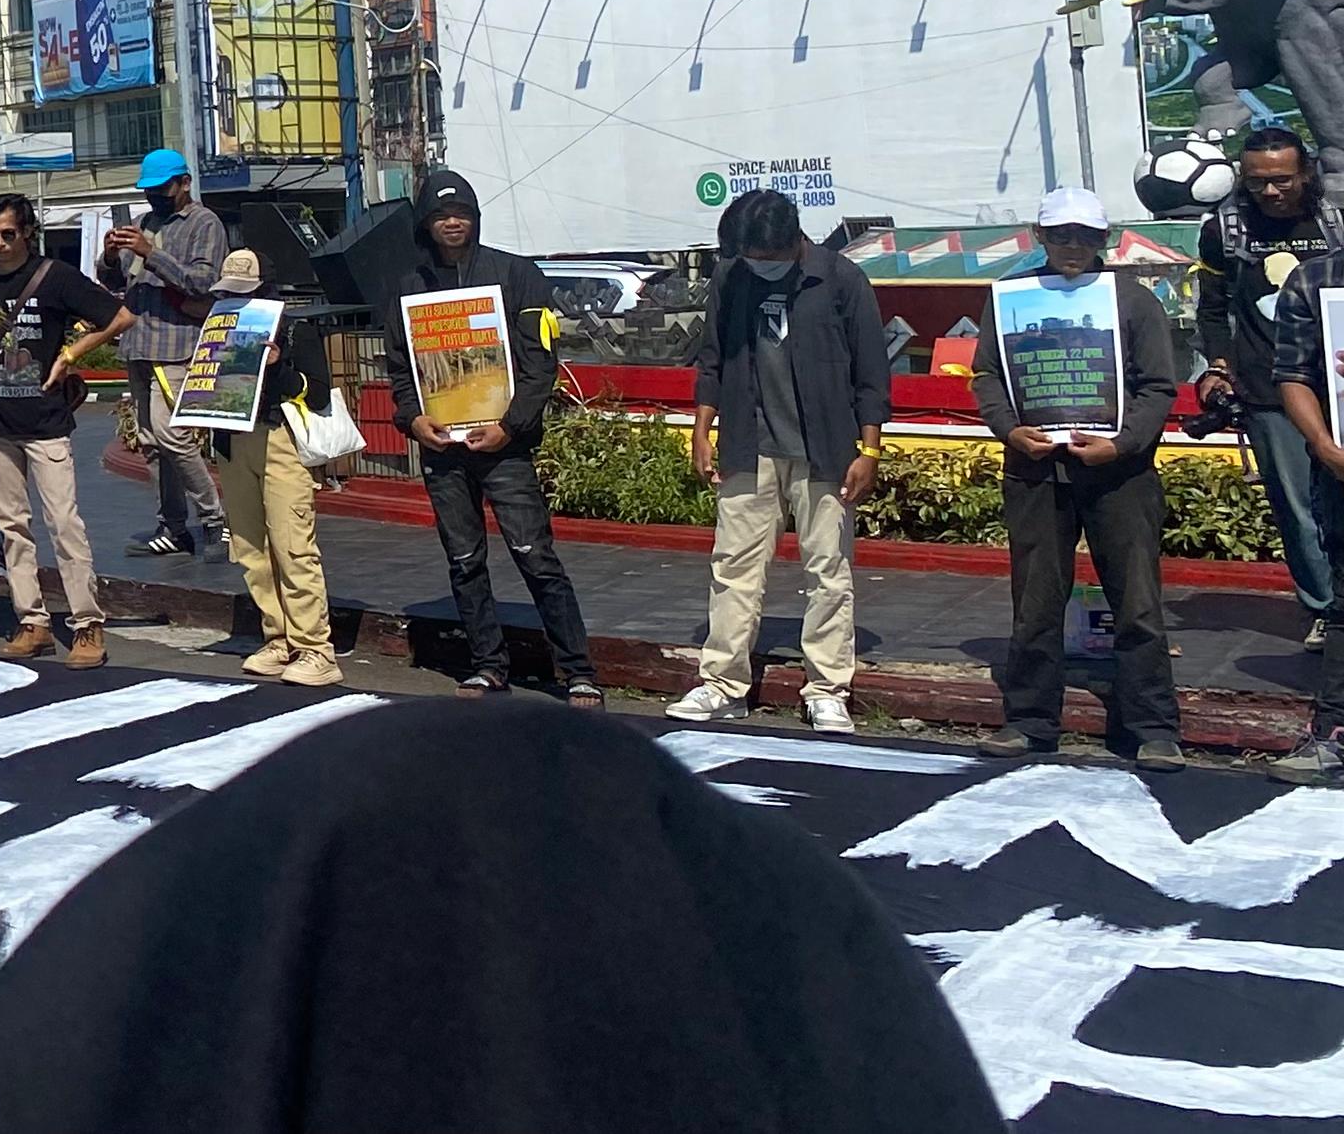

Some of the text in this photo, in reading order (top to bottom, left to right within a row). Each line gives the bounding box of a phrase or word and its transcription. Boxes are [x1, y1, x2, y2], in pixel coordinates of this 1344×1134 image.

[729, 156, 832, 176] SPACE AVAILABLE
[1070, 349, 1081, 358] 22
